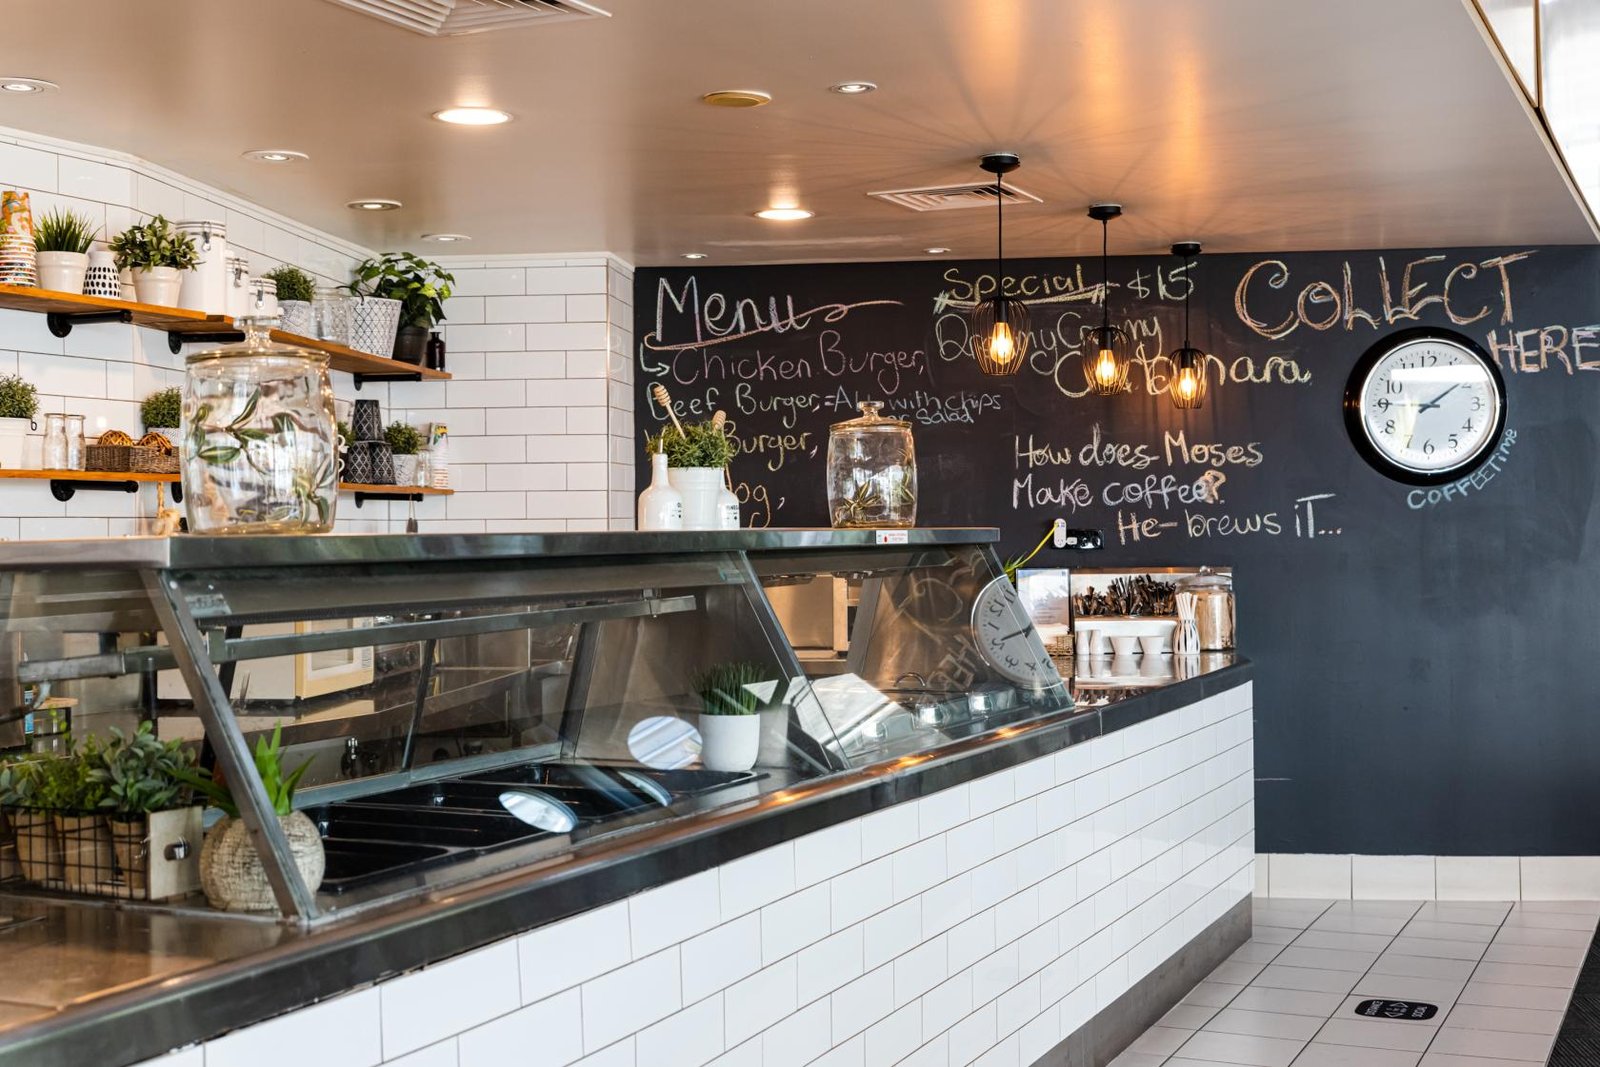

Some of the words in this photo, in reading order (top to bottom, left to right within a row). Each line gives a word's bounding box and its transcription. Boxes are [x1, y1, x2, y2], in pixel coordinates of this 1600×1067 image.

[943, 264, 1084, 301] Special
[1127, 261, 1198, 299] $15
[1234, 250, 1540, 341] COLLECT
[656, 275, 812, 343] Menu
[1486, 324, 1600, 375] HERE
[672, 348, 812, 384] Chicken
[1386, 379, 1403, 394] 10
[646, 381, 719, 420] Beef
[889, 391, 942, 410] with
[1378, 398, 1389, 413] 9
[1471, 396, 1480, 411] 3
[1385, 419, 1396, 434] 8
[1462, 418, 1473, 432] 4
[1014, 434, 1071, 469] How
[1078, 423, 1160, 469] does
[1164, 430, 1264, 467] Moses
[1404, 434, 1413, 448] 7
[1423, 438, 1435, 455] 6
[1448, 433, 1458, 449] 5
[1012, 473, 1093, 513] Make
